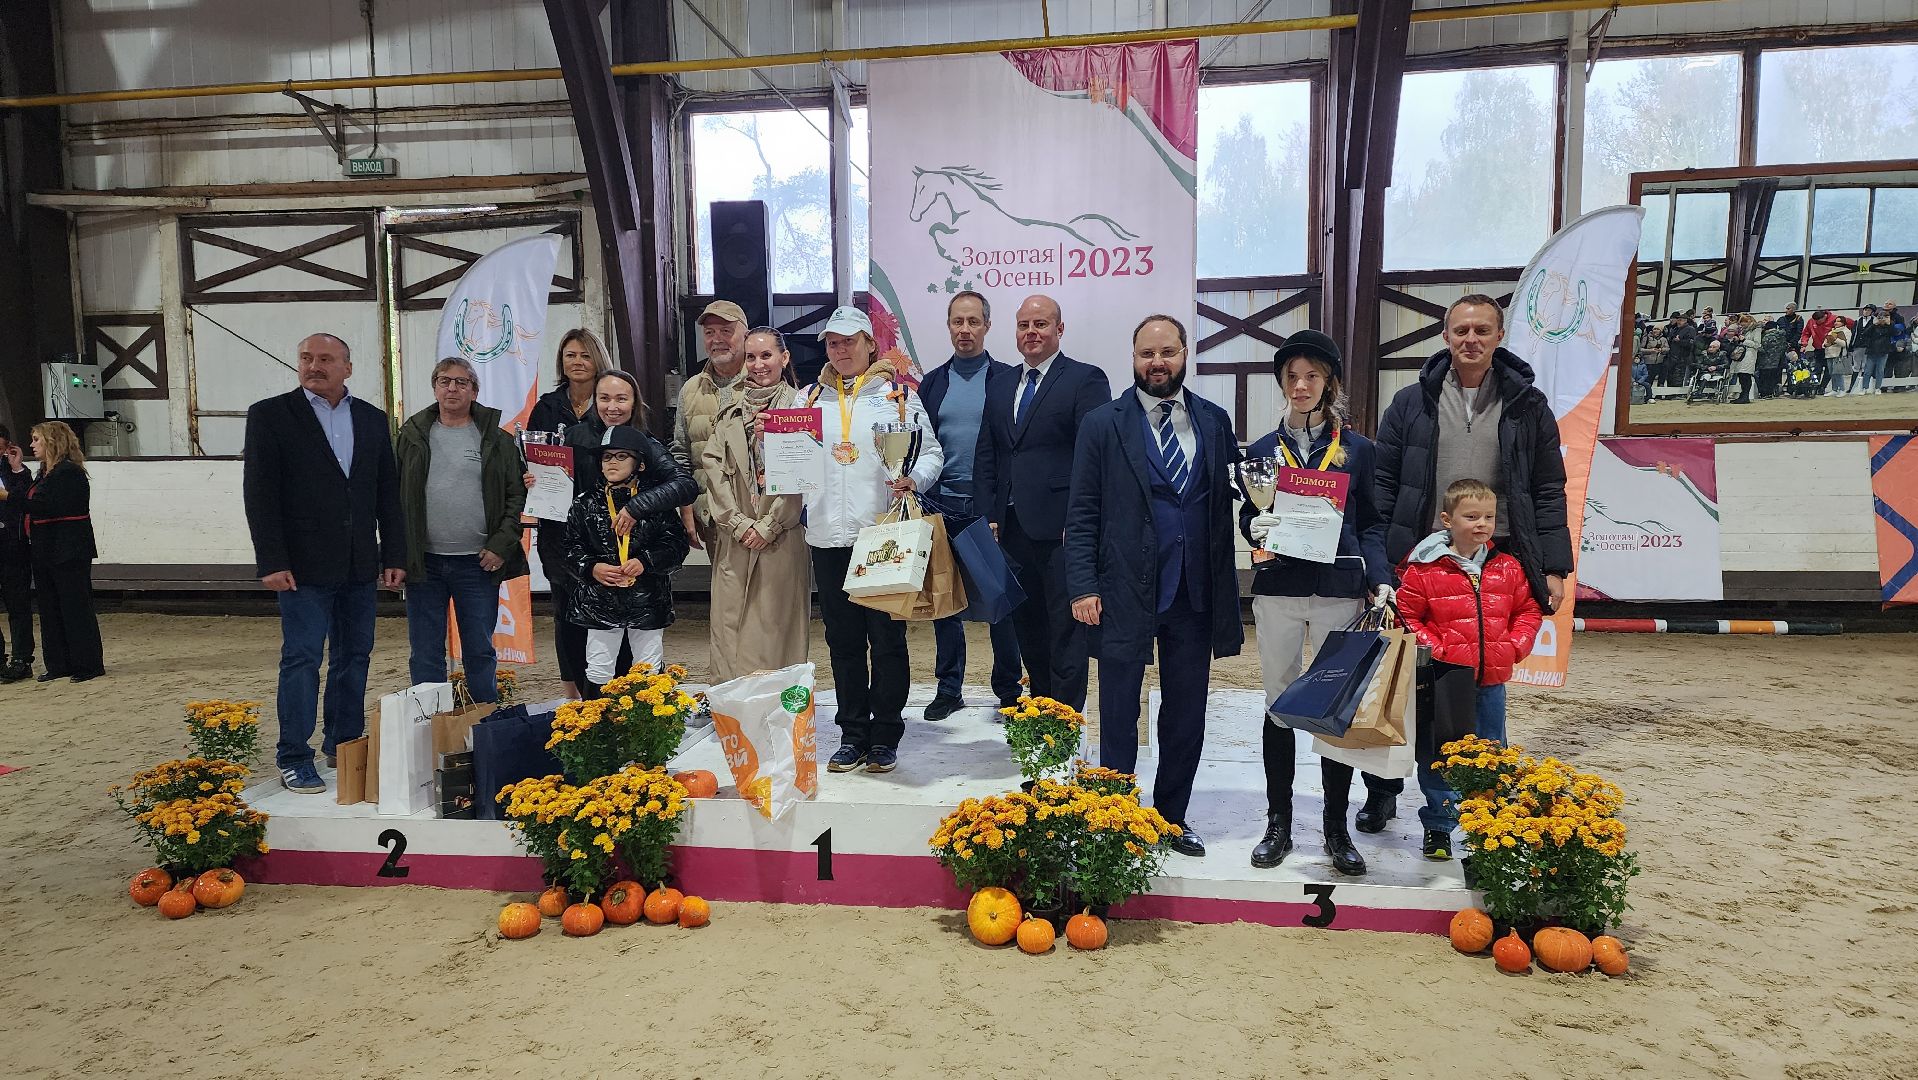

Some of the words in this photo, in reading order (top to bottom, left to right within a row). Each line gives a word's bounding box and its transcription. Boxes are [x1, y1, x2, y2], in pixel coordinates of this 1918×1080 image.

[352, 161, 382, 172] ВЫХОД
[961, 246, 1055, 267] Золотая
[1067, 245, 1154, 278] 2023
[984, 268, 1055, 288] Осень
[773, 414, 813, 425] Грамота
[533, 447, 566, 459] Грамота
[1289, 473, 1337, 489] Грамота
[1588, 531, 1634, 541] Золотая
[1640, 534, 1683, 548] 2023
[1600, 541, 1635, 551] Осень
[376, 828, 409, 878] 2
[810, 826, 834, 881] 1
[1301, 883, 1337, 928] 3
